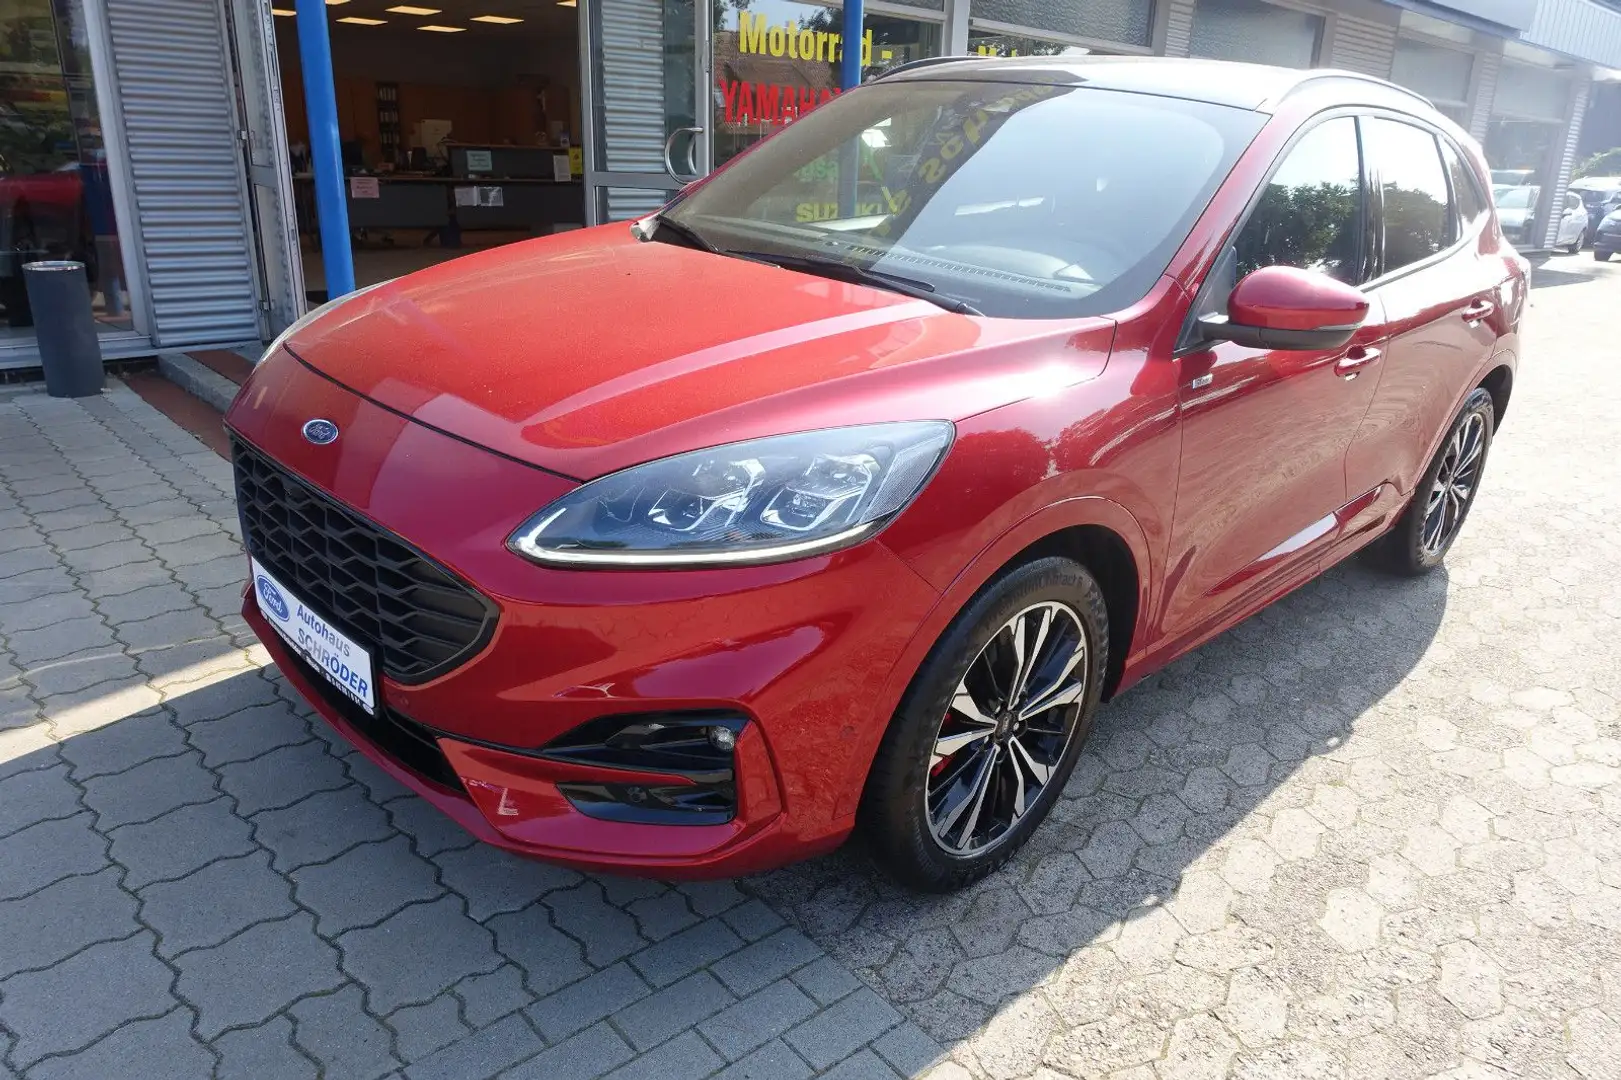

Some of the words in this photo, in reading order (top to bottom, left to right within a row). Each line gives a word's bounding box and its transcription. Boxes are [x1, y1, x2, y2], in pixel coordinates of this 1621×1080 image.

[739, 10, 872, 67] Motorrd
[262, 581, 284, 614] Ford
[297, 604, 350, 657] Autohaus
[298, 628, 368, 698] SCHRÖDER
